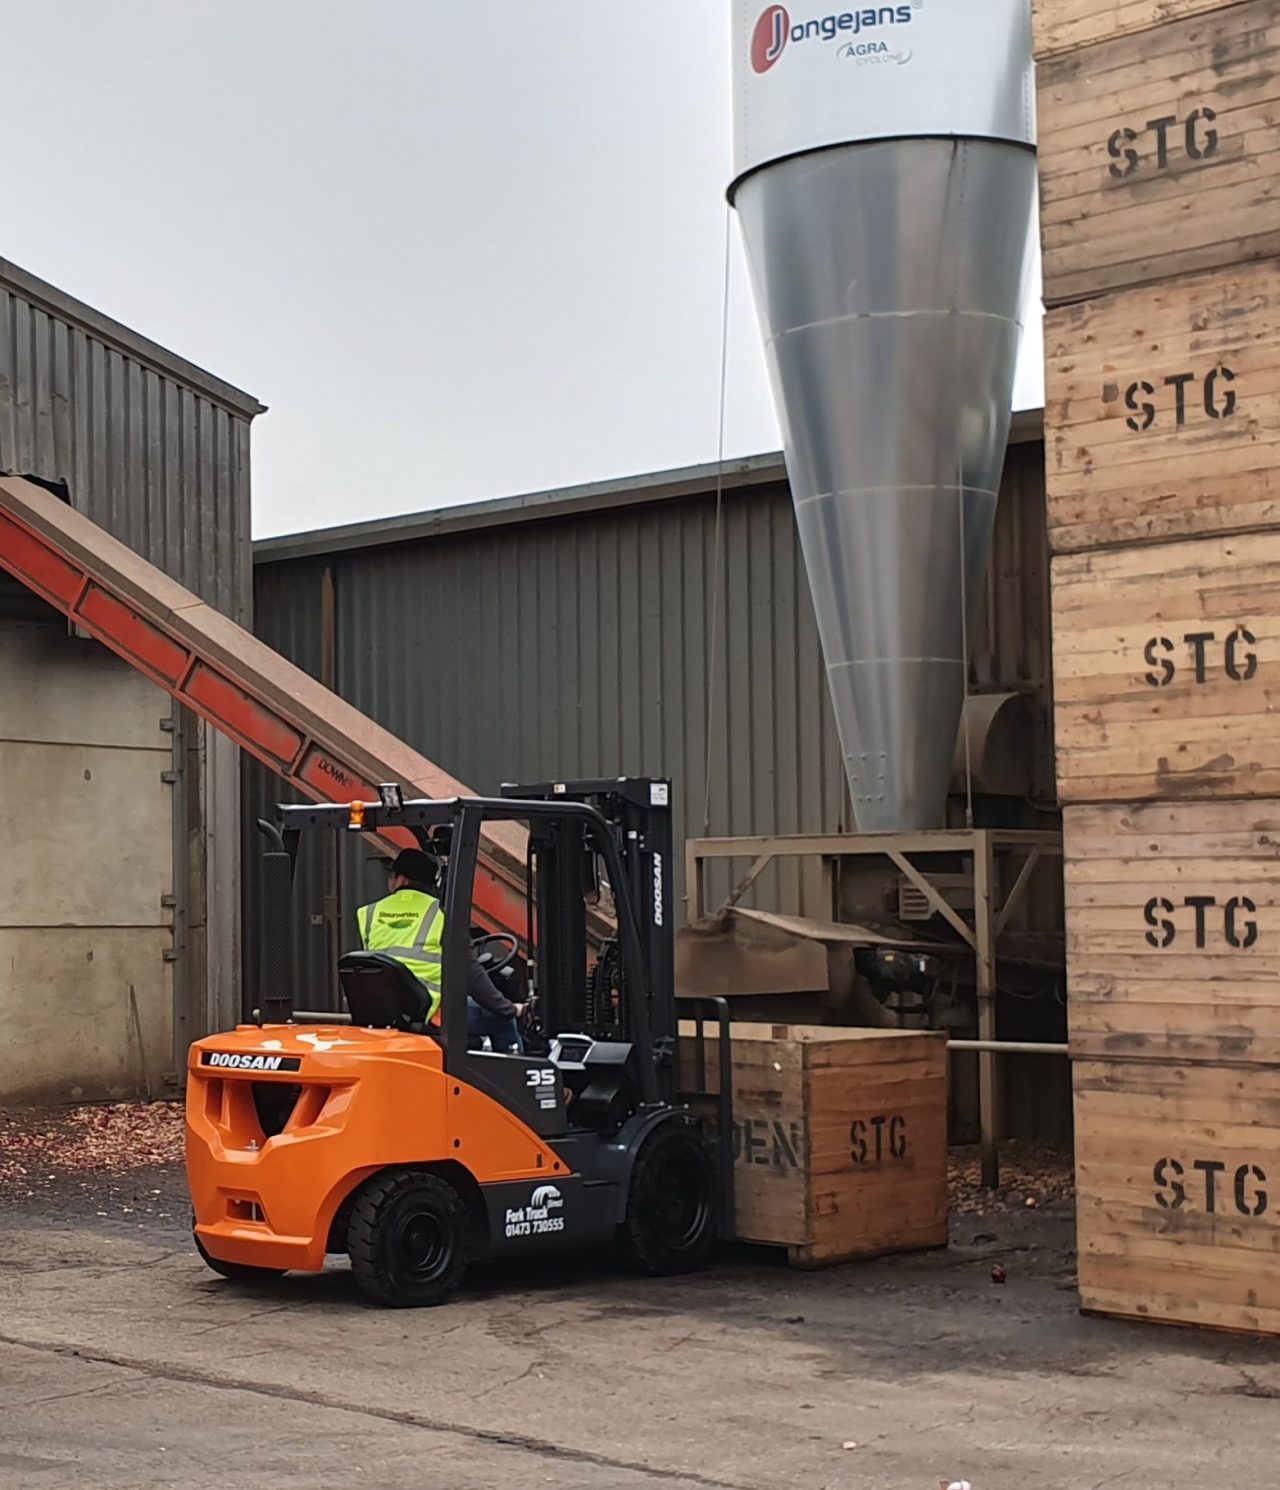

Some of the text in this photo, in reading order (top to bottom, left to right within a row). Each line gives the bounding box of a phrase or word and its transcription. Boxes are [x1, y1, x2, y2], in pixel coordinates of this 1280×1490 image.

[767, 6, 911, 58] Jongejans
[845, 41, 888, 58] AGRA
[1107, 106, 1218, 178] STG
[1125, 367, 1236, 432] STG
[1144, 629, 1257, 687] STG
[653, 852, 663, 927] DOOSAN
[1144, 896, 1258, 948] STG
[209, 1053, 282, 1070] DOOSAN
[526, 1069, 556, 1086] 35
[850, 1115, 906, 1163] STG
[1153, 1158, 1267, 1216] STG
[505, 1217, 564, 1237] 01473 730555
[506, 1205, 548, 1223] Fork Truck
